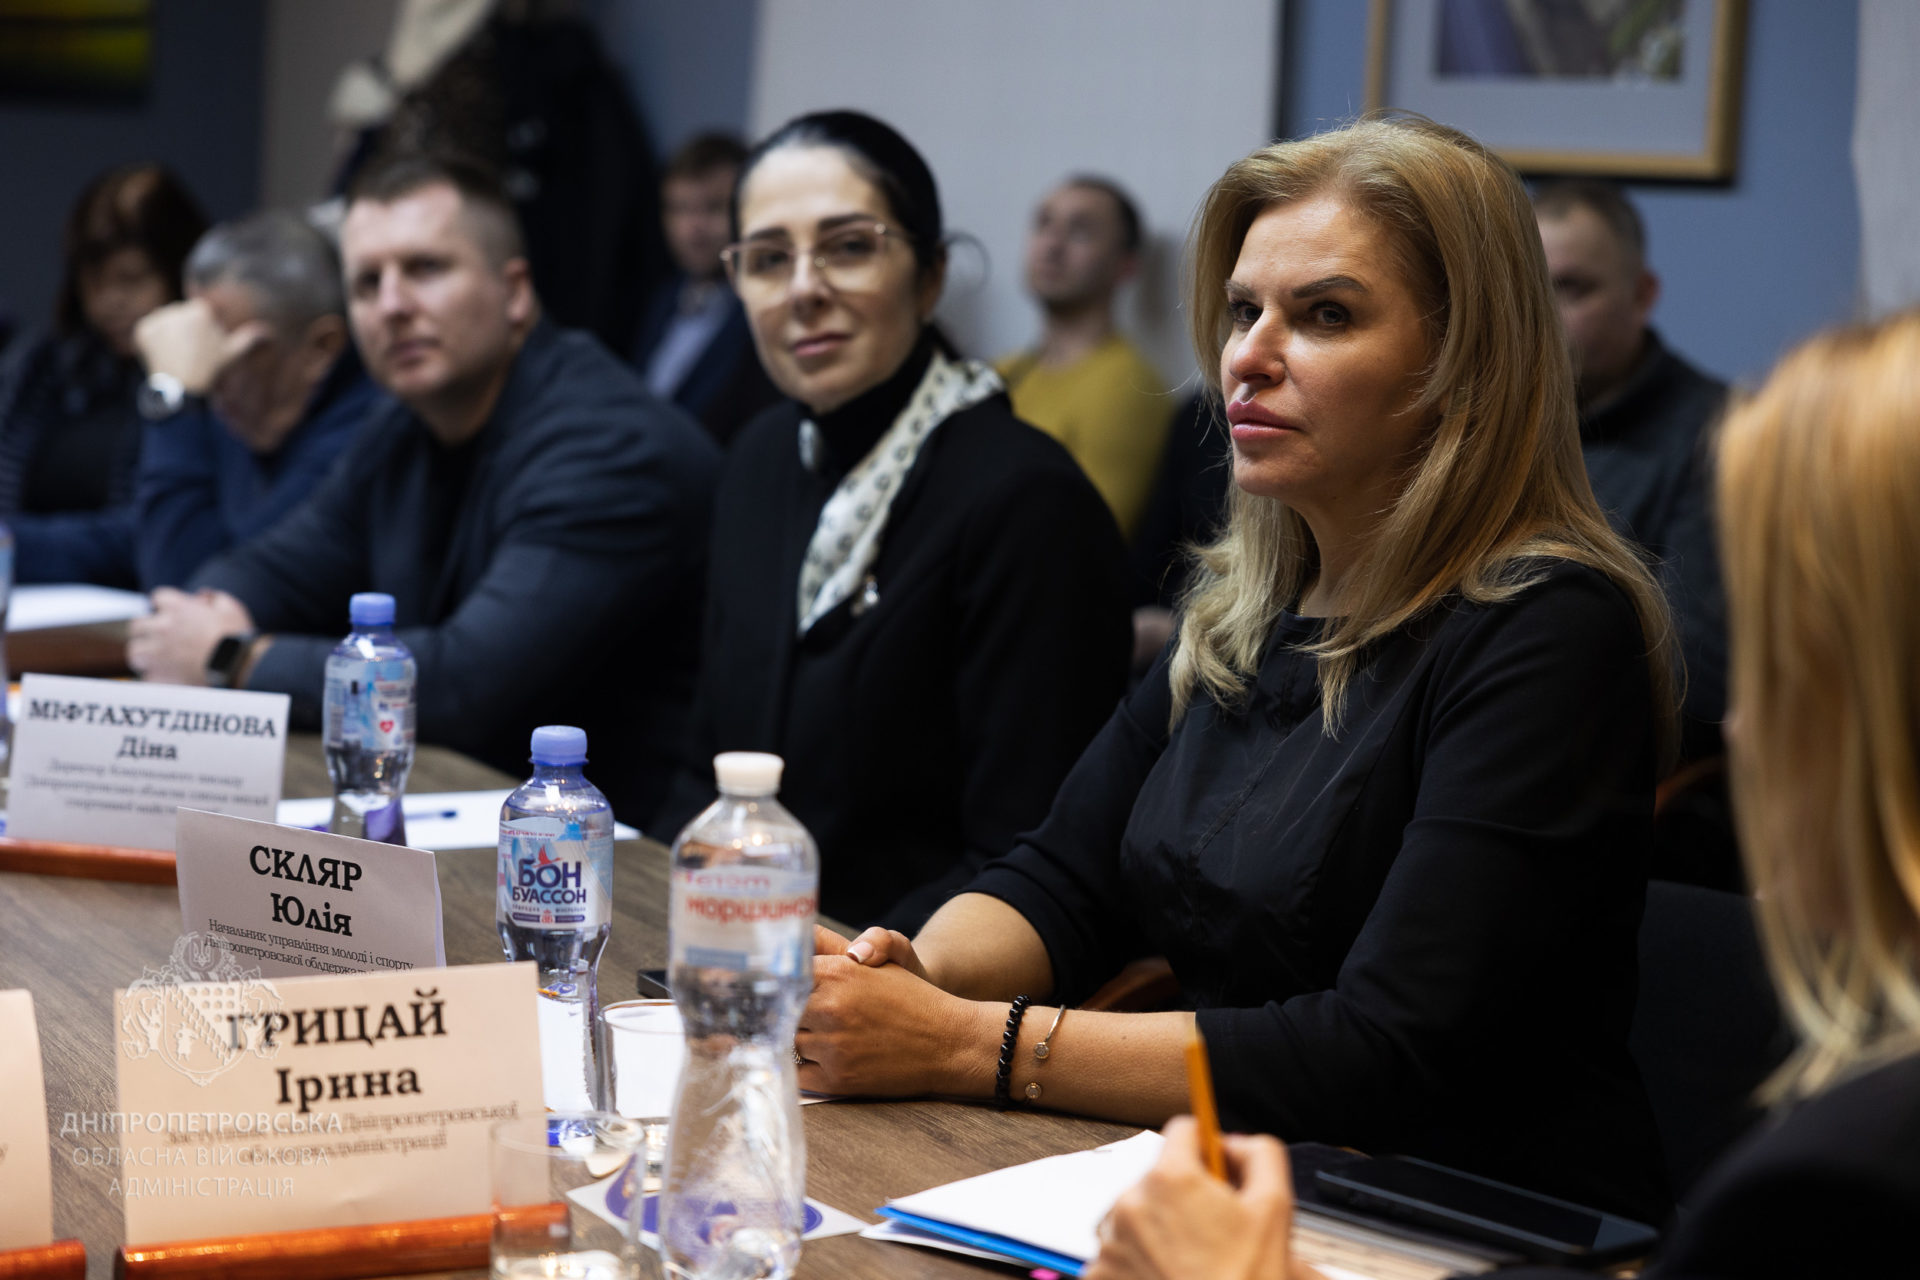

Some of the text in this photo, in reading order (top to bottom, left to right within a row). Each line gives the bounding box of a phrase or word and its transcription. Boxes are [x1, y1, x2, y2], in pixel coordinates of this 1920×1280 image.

[28, 699, 277, 738] МІФТАХУТДІНОВА
[117, 735, 178, 760] Діна
[249, 845, 363, 892] СКЛЯР
[518, 858, 582, 889] БОН
[270, 892, 353, 937] Юлія
[512, 886, 587, 904] БУАССОН
[208, 918, 414, 972] Начальник управління молоді і спорту
[226, 986, 448, 1050] ГРИЦАЙ
[275, 1066, 422, 1113] Ірина
